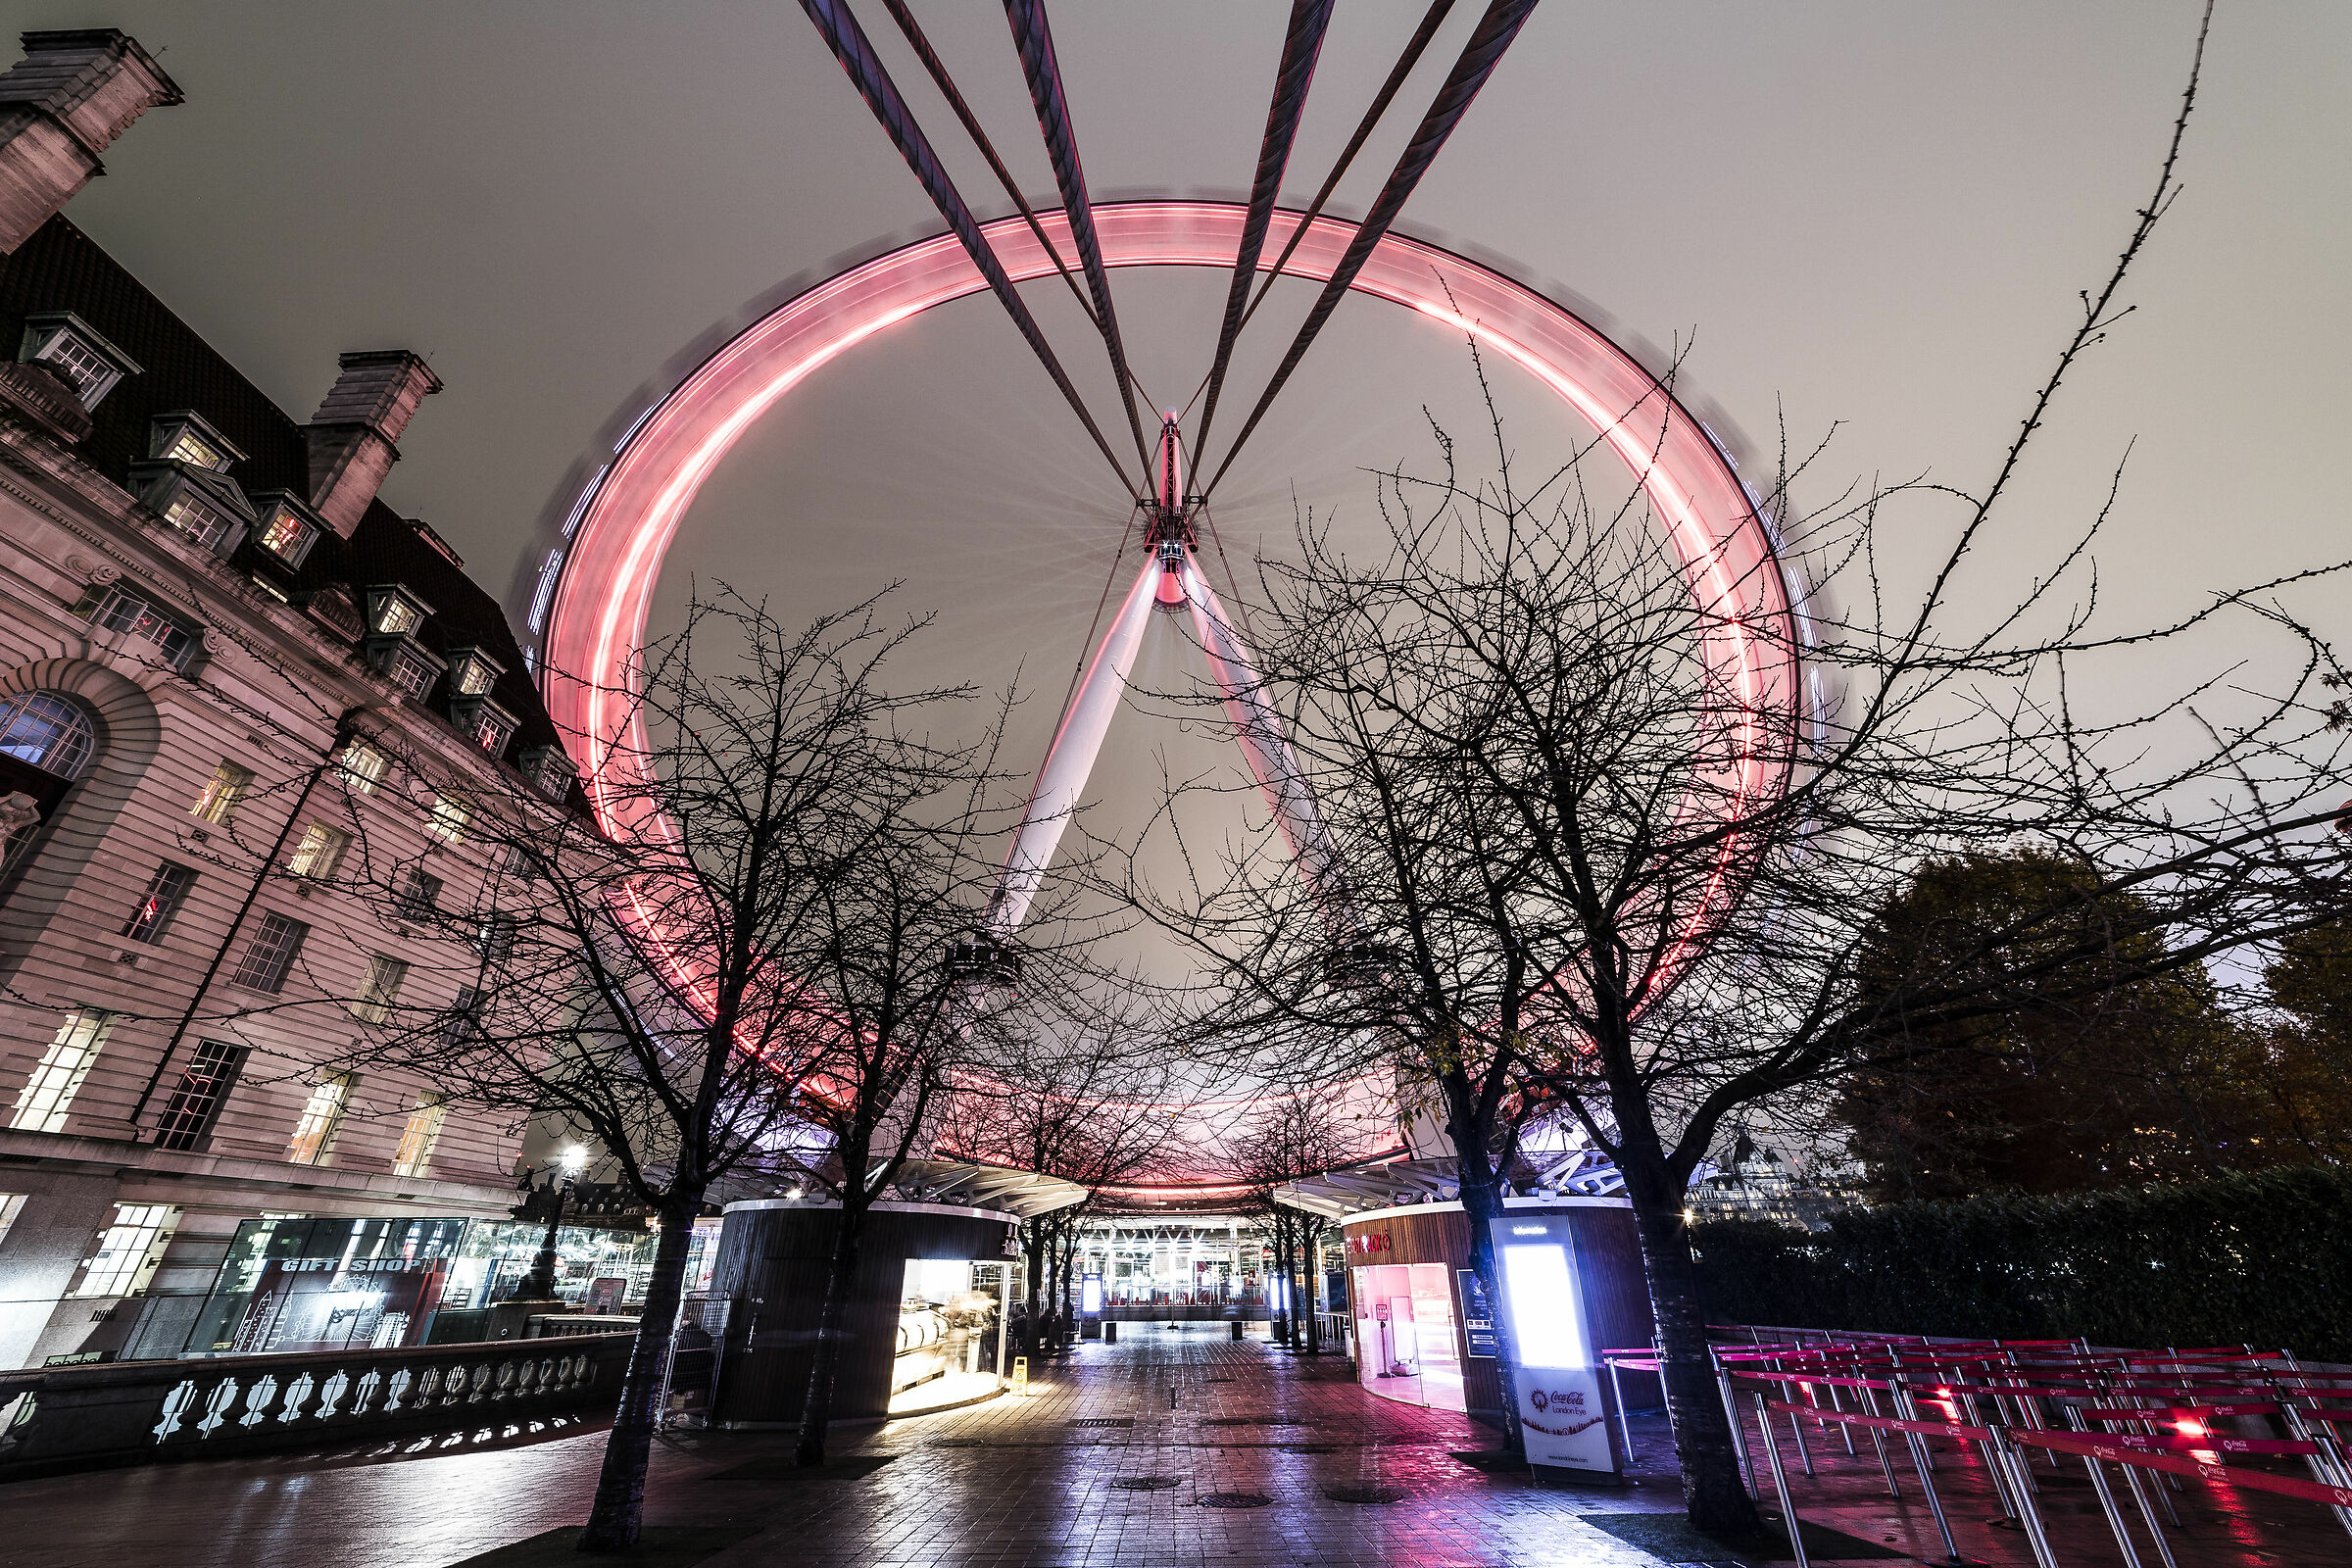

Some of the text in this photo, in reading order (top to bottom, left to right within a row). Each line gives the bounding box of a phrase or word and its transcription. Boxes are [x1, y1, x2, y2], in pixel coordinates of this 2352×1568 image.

[280, 1259, 421, 1272] GIFT SHOP
[1575, 1406, 1586, 1416] Eye
